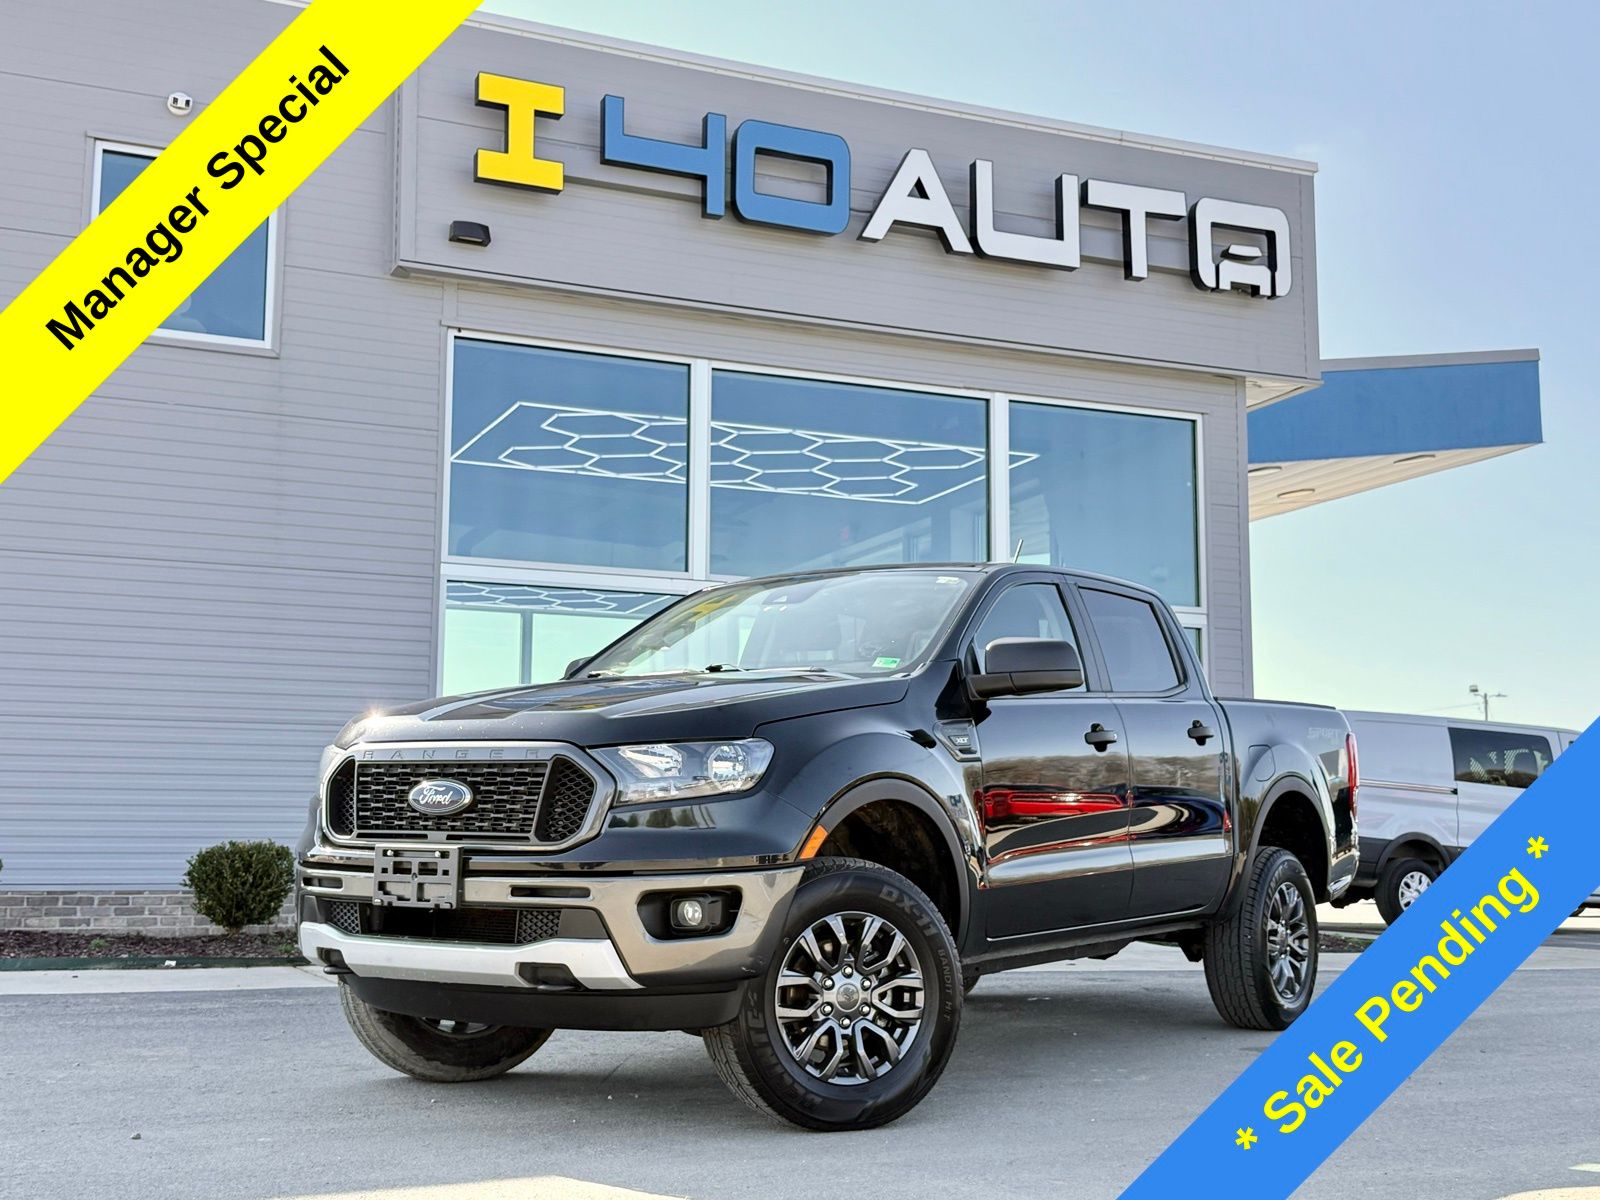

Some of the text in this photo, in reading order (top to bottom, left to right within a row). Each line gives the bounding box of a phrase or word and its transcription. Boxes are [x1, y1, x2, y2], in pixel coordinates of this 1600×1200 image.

[475, 72, 565, 195] I
[600, 94, 851, 237] 40
[362, 749, 540, 760] RANGER
[418, 786, 455, 806] Ford
[880, 884, 939, 937] DX-11
